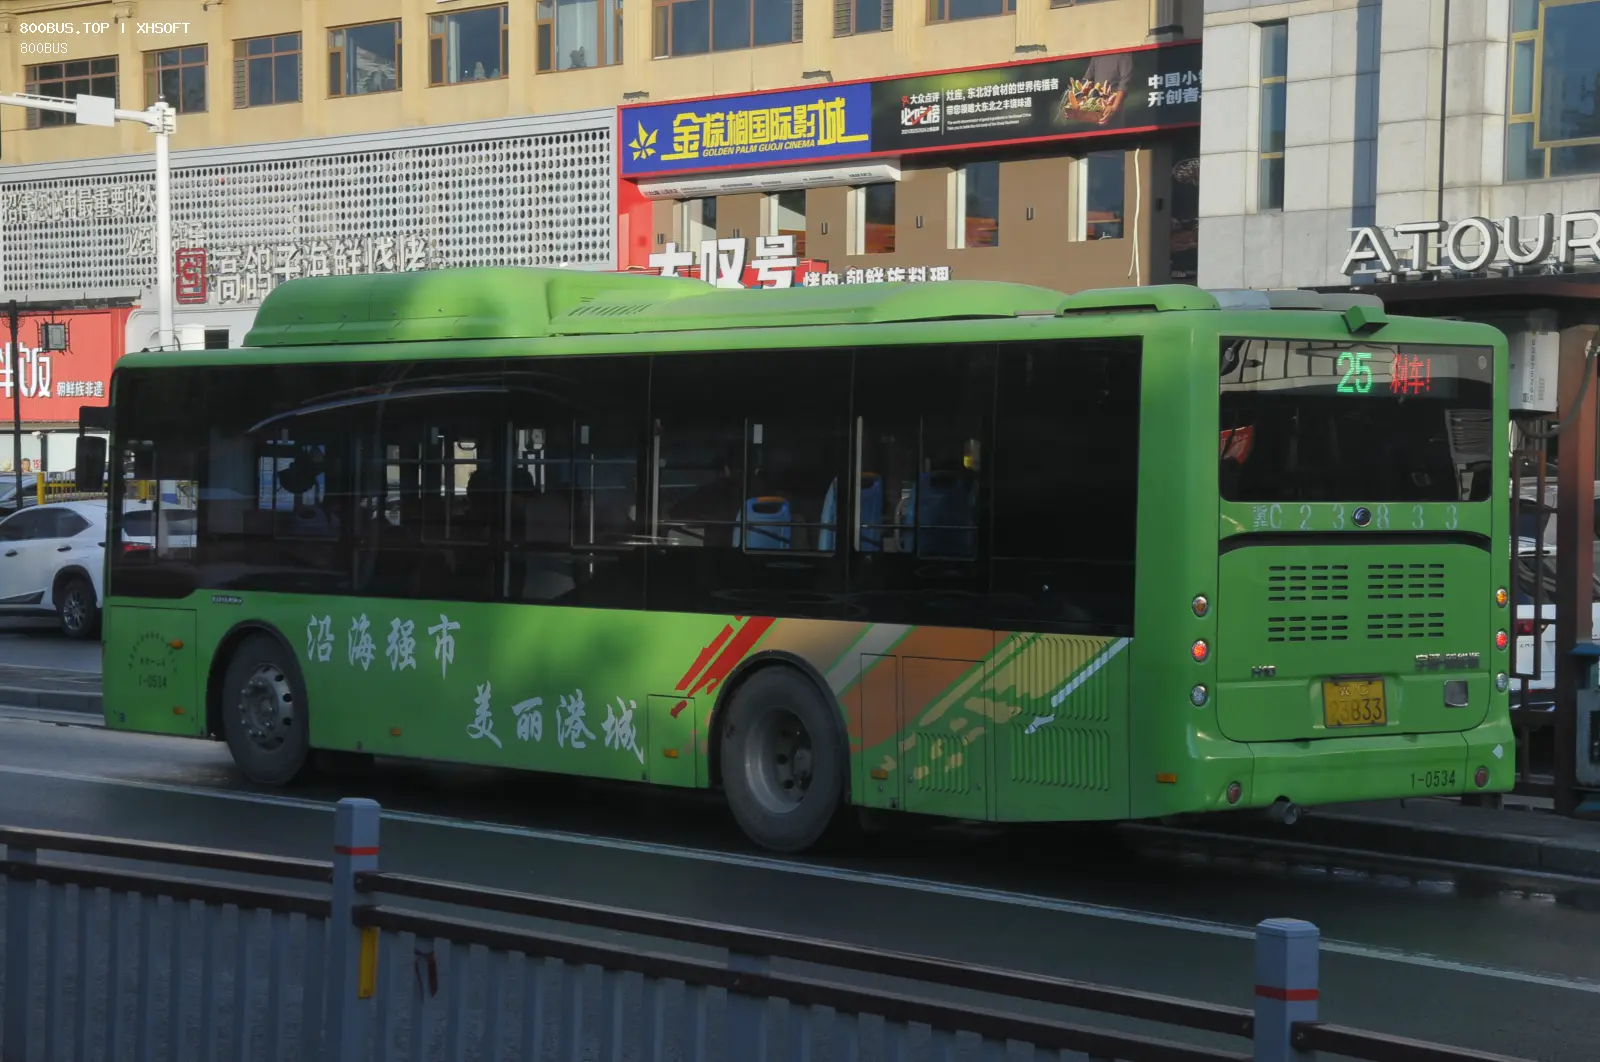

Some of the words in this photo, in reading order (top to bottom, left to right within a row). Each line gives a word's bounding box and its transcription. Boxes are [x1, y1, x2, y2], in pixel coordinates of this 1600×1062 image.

[1148, 69, 1202, 89] 中国小
[910, 91, 940, 105] 大众点评
[660, 97, 869, 161] 金棕榈国际影城
[702, 146, 735, 157] GOLDEN
[735, 144, 758, 155] PALM
[758, 142, 783, 152] GUOJI
[784, 139, 815, 150] CINEMA
[1340, 210, 1600, 276] ATOUR
[1336, 352, 1373, 393] 25
[57, 381, 104, 397] 朝鲜族非遗
[306, 613, 461, 680] 沿海强市
[1330, 697, 1382, 721] 23833
[466, 680, 645, 765] 美丽港城
[1410, 769, 1456, 790] 1-0534
